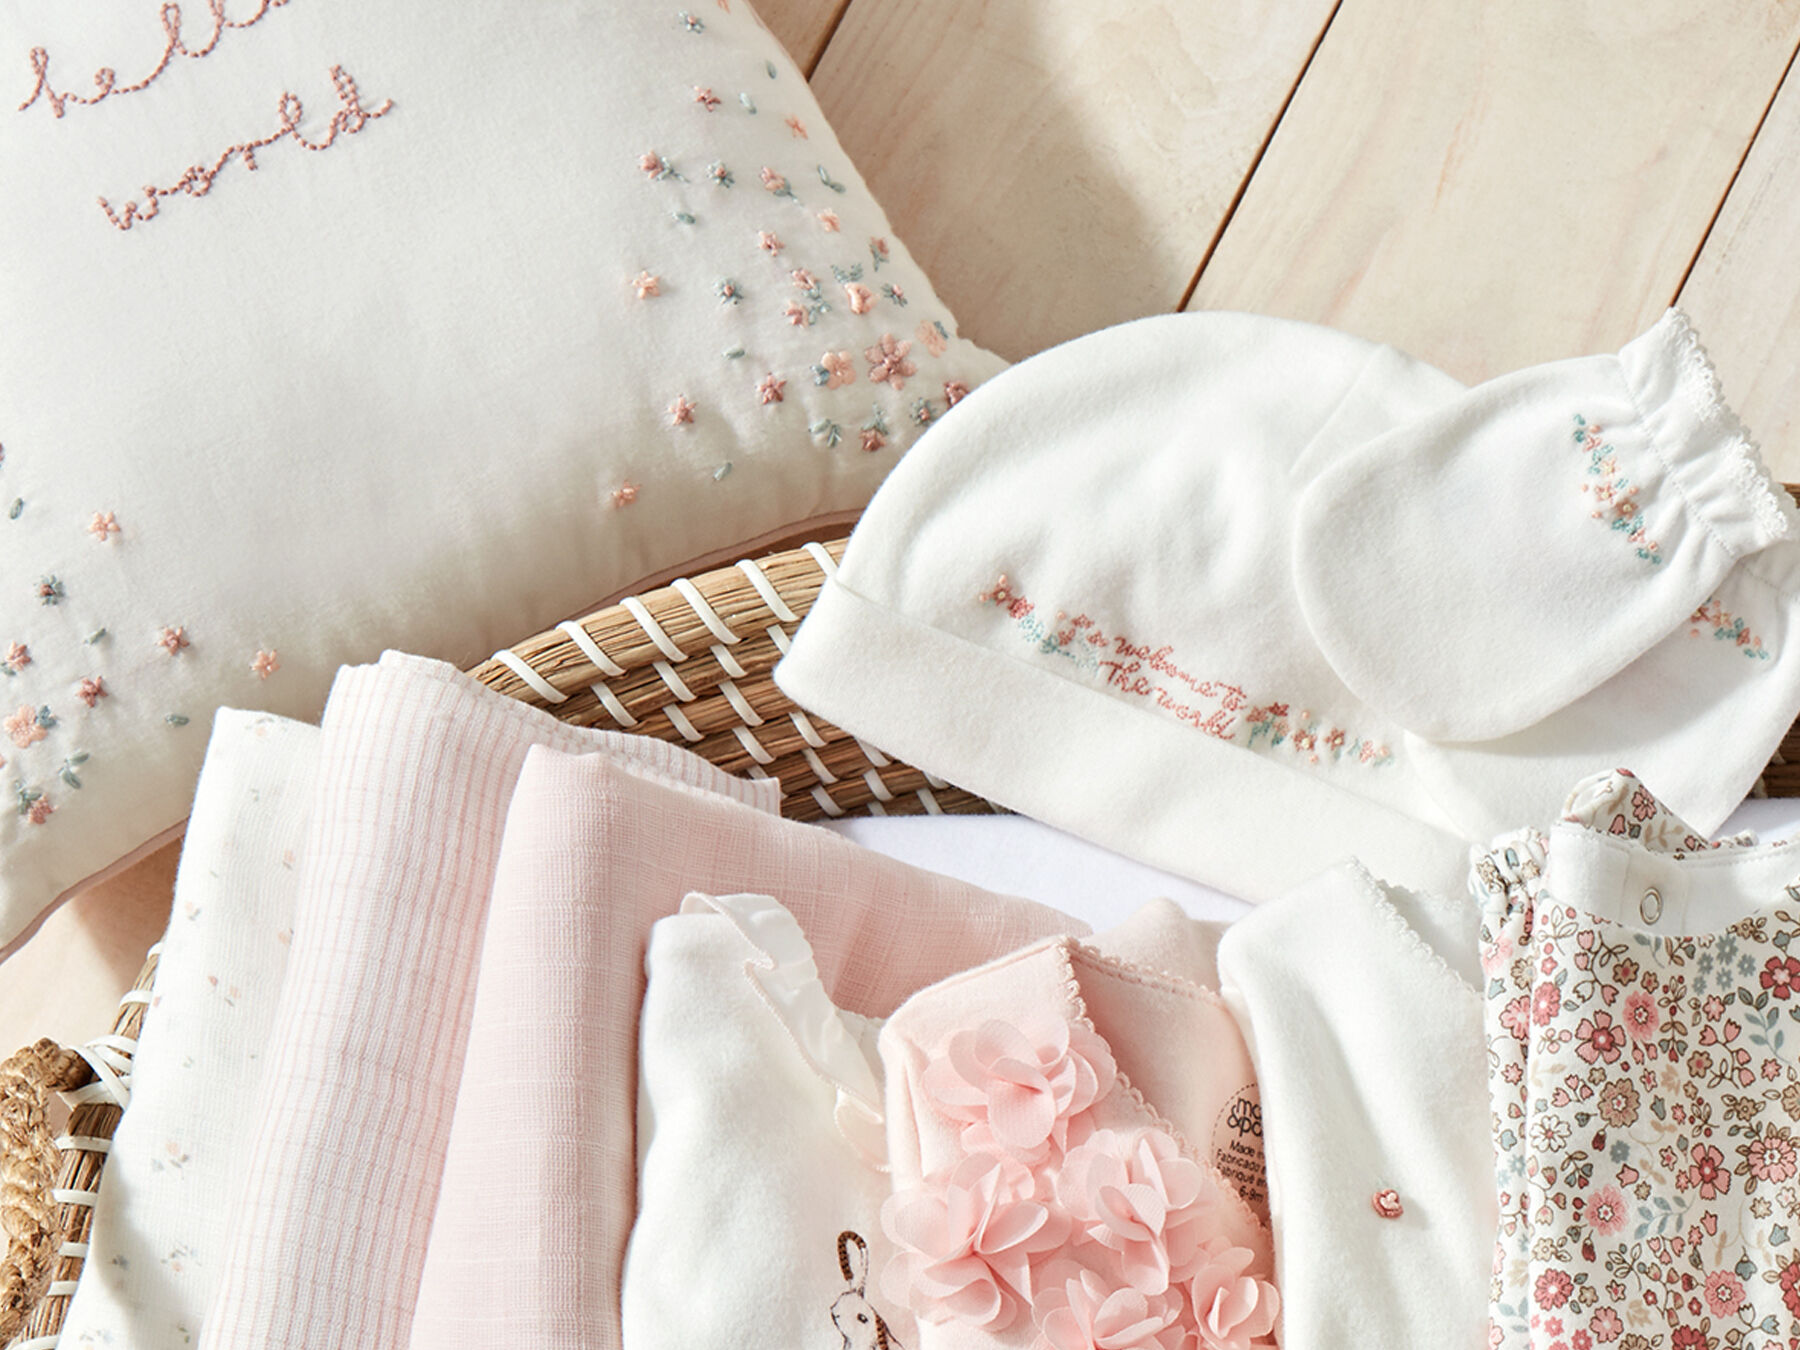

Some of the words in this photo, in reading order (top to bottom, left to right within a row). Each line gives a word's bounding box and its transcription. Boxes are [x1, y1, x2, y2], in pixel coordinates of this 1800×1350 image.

[98, 64, 394, 231] world
[1114, 636, 1217, 698] welcome
[1151, 686, 1236, 740] world
[1216, 1148, 1261, 1173] Fabricado
[1229, 1140, 1255, 1158] Made
